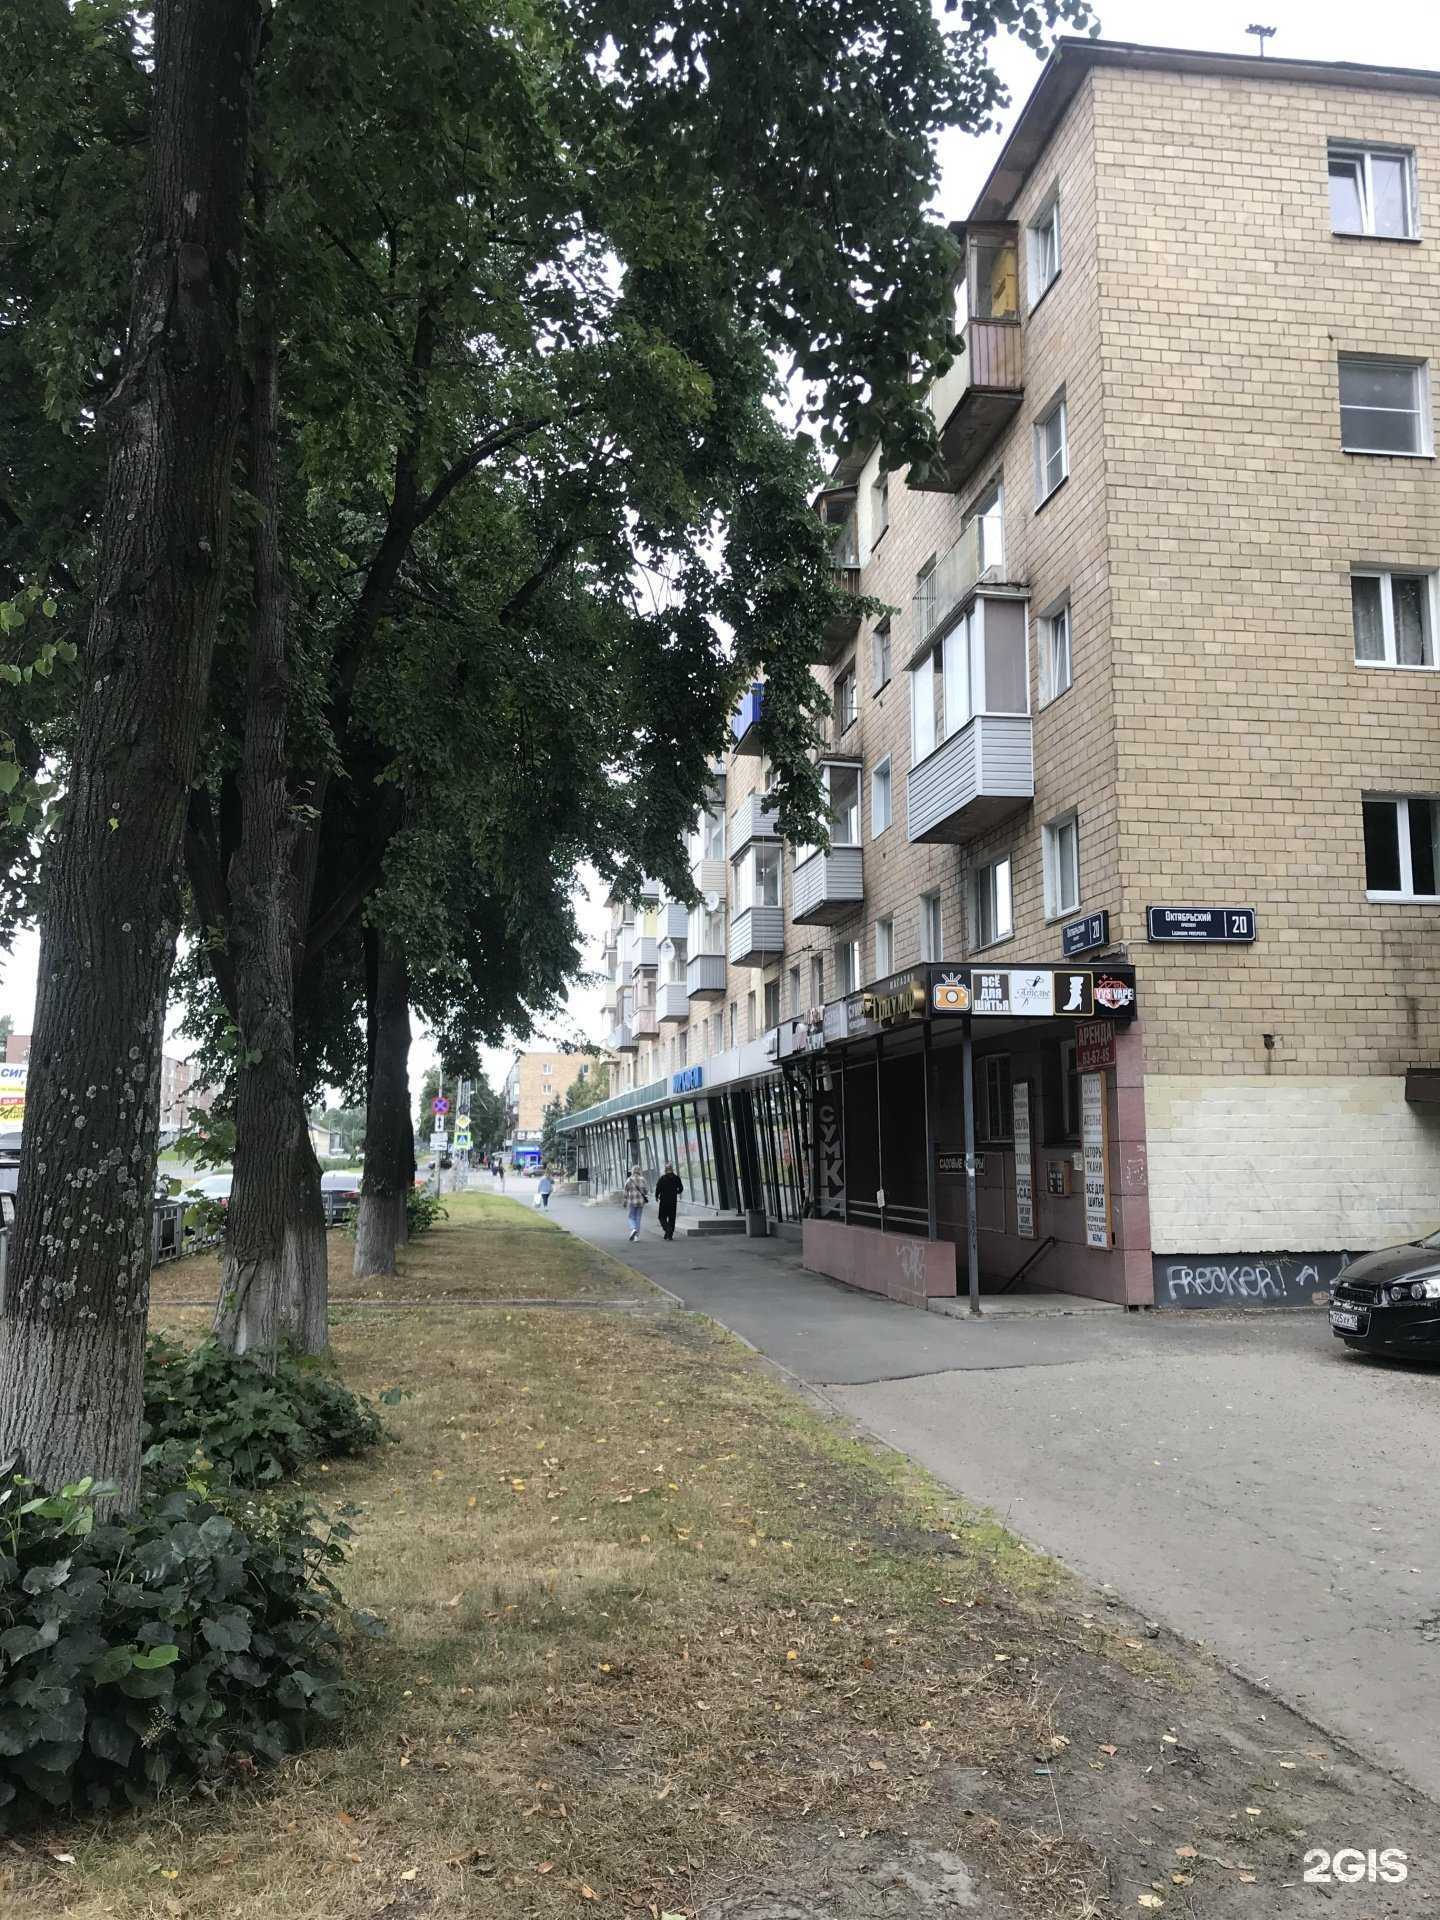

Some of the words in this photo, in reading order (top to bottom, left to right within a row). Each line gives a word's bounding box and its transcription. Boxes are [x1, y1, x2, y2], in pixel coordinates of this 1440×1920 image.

[1092, 920, 1100, 939] 20
[1231, 915, 1248, 934] 20
[981, 974, 1001, 987] ВСЁ
[980, 988, 1002, 1000] ДЛЯ
[1095, 988, 1111, 1000] VVS
[1112, 988, 1134, 1000] VAPE
[974, 1000, 1010, 1011] ШИТЬЯ
[1078, 1022, 1113, 1048] АРЕНДА
[1084, 1146, 1103, 1158] ШТОРЫ
[819, 1105, 846, 1217] СУМКИ
[1086, 1160, 1103, 1175] ТКАНИ
[1087, 1196, 1104, 1209] ШИТЬЯ
